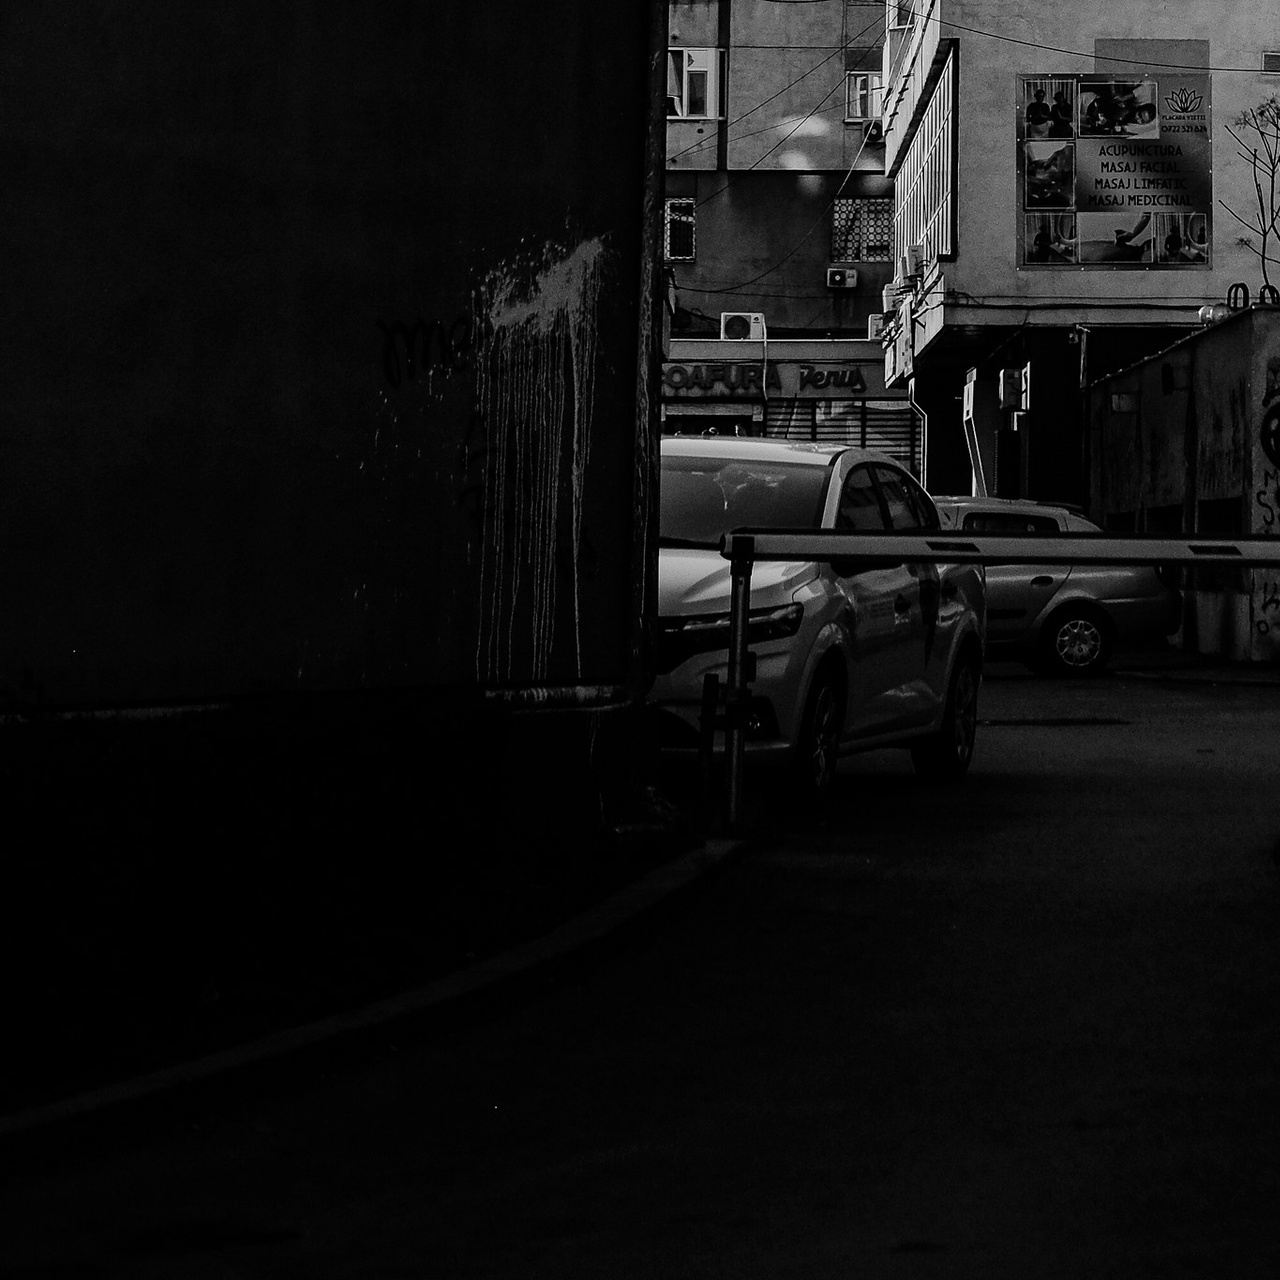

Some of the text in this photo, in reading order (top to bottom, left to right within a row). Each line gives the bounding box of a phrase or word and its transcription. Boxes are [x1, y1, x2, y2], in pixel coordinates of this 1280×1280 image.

[1099, 145, 1183, 156] ACUPUNCTURA
[1101, 162, 1180, 173] MASAJ FACIAL
[1094, 178, 1187, 190] MASAJ LIMFATIC
[1088, 194, 1193, 206] MASAJ MEDICINAL
[662, 364, 782, 391] OAFURA
